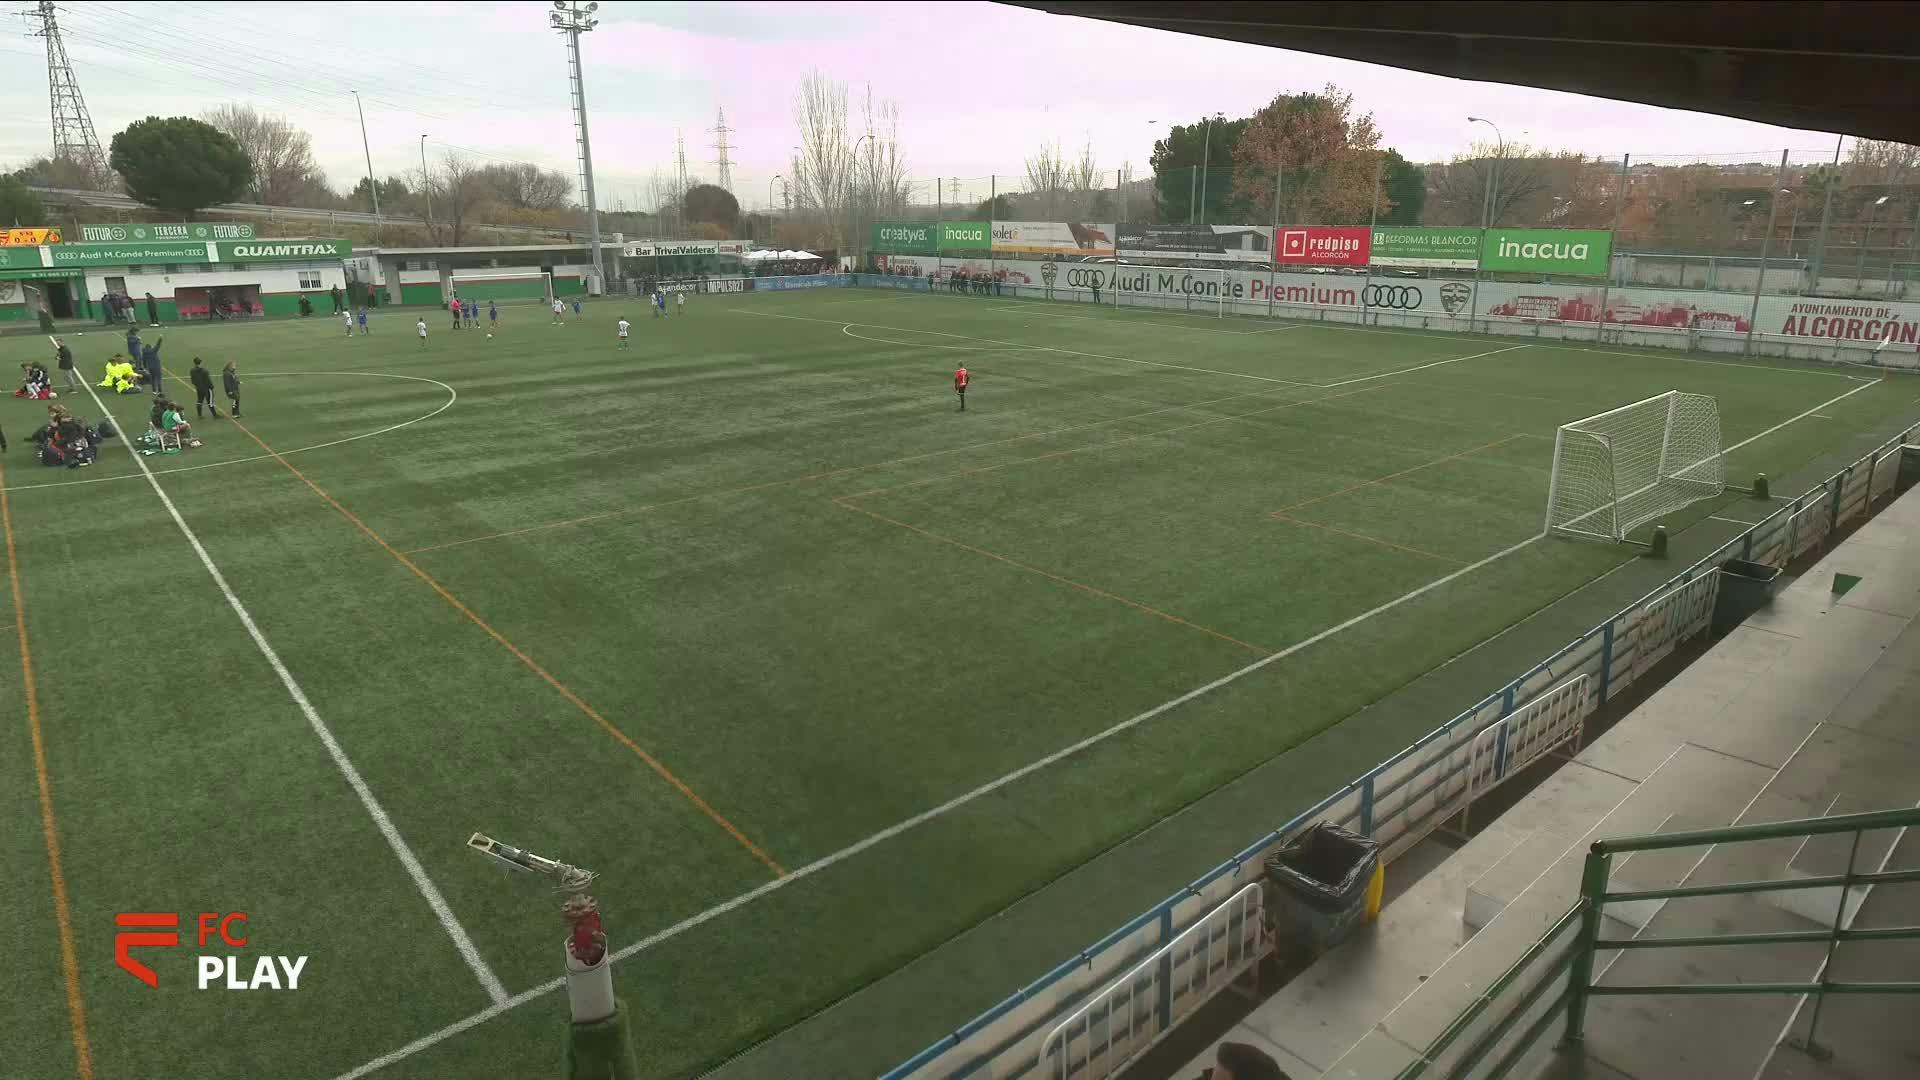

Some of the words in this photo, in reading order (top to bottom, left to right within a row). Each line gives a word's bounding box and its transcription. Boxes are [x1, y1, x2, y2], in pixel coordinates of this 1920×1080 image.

[153, 226, 188, 236] TERCERA
[945, 226, 982, 241] inacua
[1309, 236, 1359, 252] redpiso
[1385, 235, 1428, 245] REFORMAS
[1431, 236, 1477, 246] BLANCOR
[145, 249, 184, 257] Premium
[233, 244, 337, 257] QUAMTRAX
[635, 247, 651, 255] Bar
[1498, 236, 1588, 261] inacua
[1109, 273, 1150, 293] Audi
[1251, 279, 1355, 306] Premium
[1790, 303, 1872, 317] AYUNTAMIENTO
[1876, 308, 1891, 319] DE
[1782, 314, 1919, 343] ALCORCÓN
